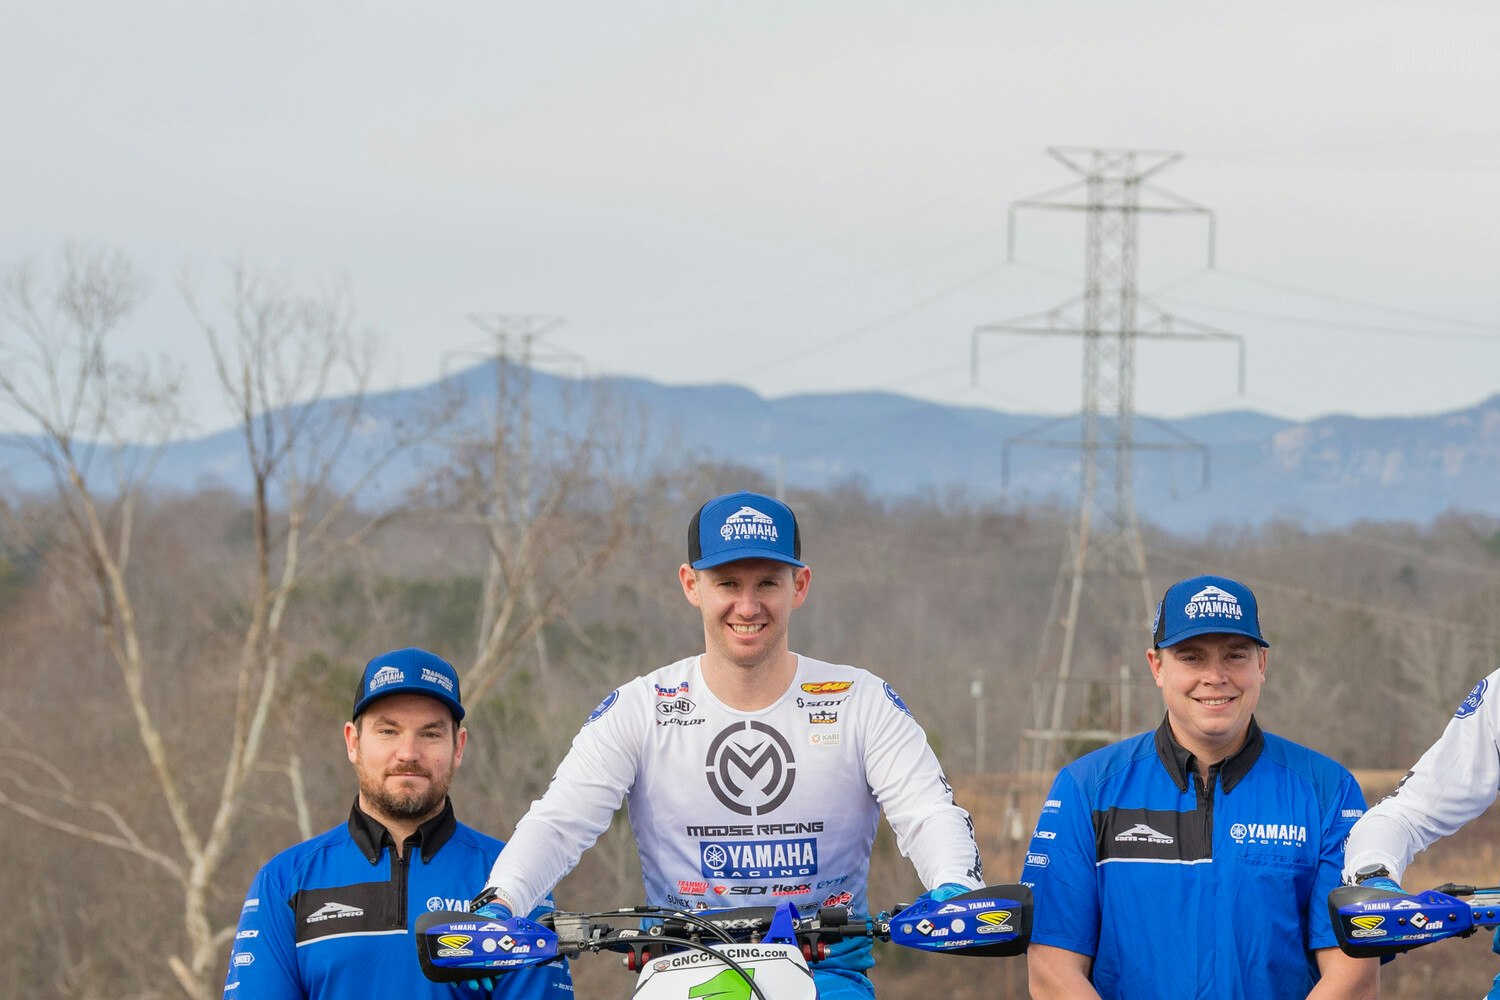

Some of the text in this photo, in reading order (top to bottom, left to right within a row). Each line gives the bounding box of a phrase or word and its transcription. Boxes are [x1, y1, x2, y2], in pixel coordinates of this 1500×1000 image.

[733, 523, 778, 538] YAMAHA
[1197, 601, 1243, 616] YAMAHA
[1189, 612, 1241, 620] RACING
[377, 672, 404, 685] YAMAHA
[686, 822, 824, 837] MOOSE RACING
[1248, 823, 1307, 842] YAMAHA
[1235, 838, 1302, 848] RACING
[727, 842, 816, 869] YAMAHA
[713, 868, 810, 877] RACING
[677, 880, 710, 888] TRAMMELL
[445, 899, 472, 912] YAM
[968, 901, 996, 909] YAMAHA
[1363, 903, 1391, 911] YAMAHA
